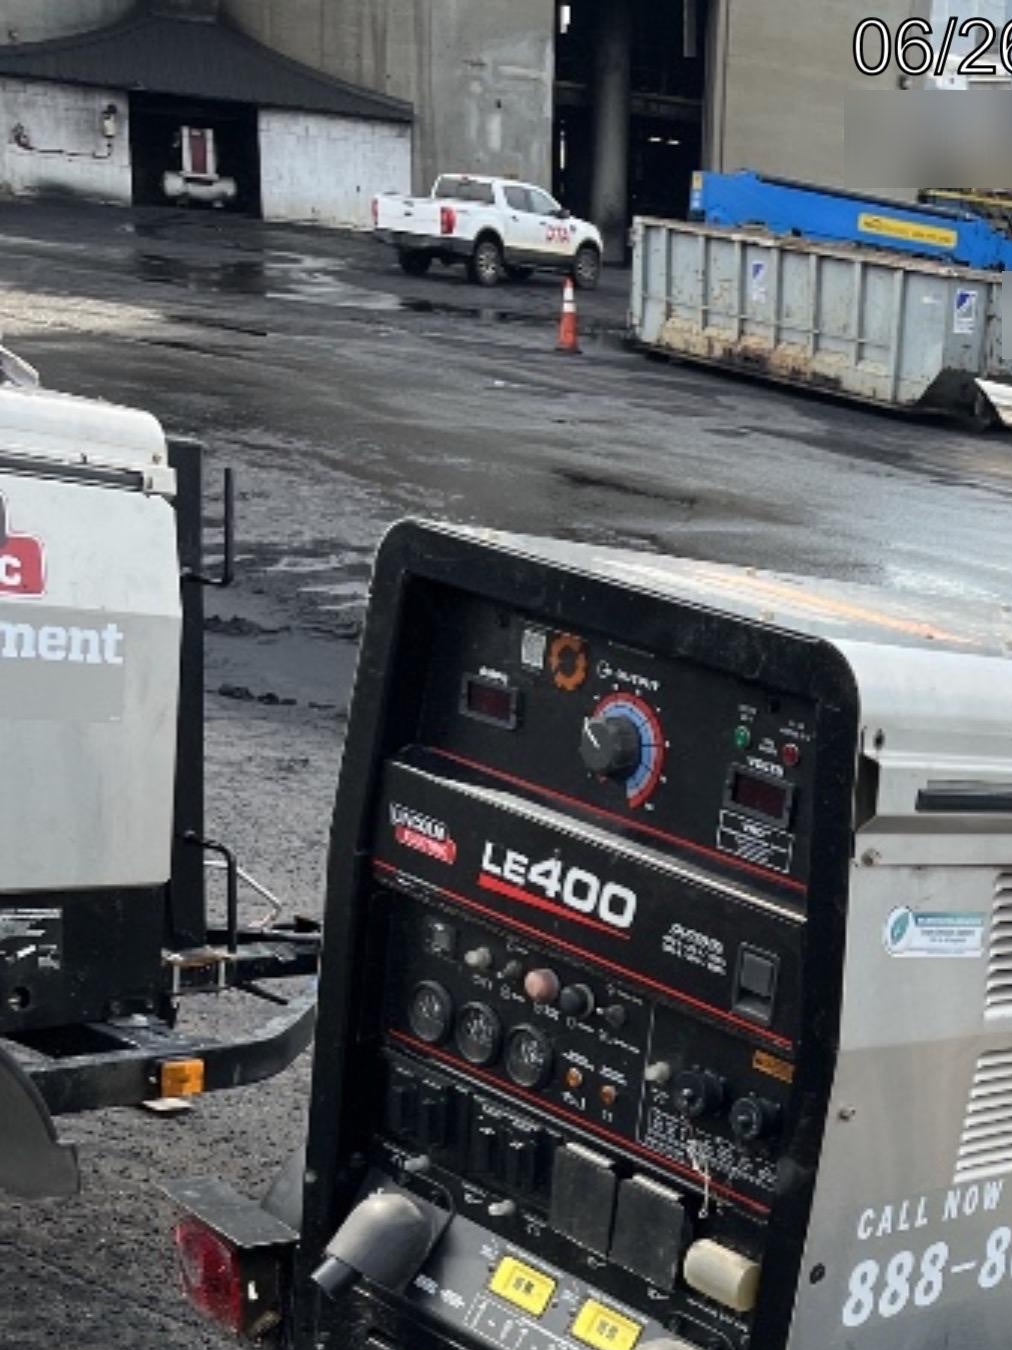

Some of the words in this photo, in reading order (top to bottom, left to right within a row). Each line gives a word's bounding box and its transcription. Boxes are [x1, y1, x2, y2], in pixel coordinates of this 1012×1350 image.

[481, 839, 637, 929] LE400
[857, 1196, 929, 1240] CALL
[942, 1179, 1005, 1222] NOW
